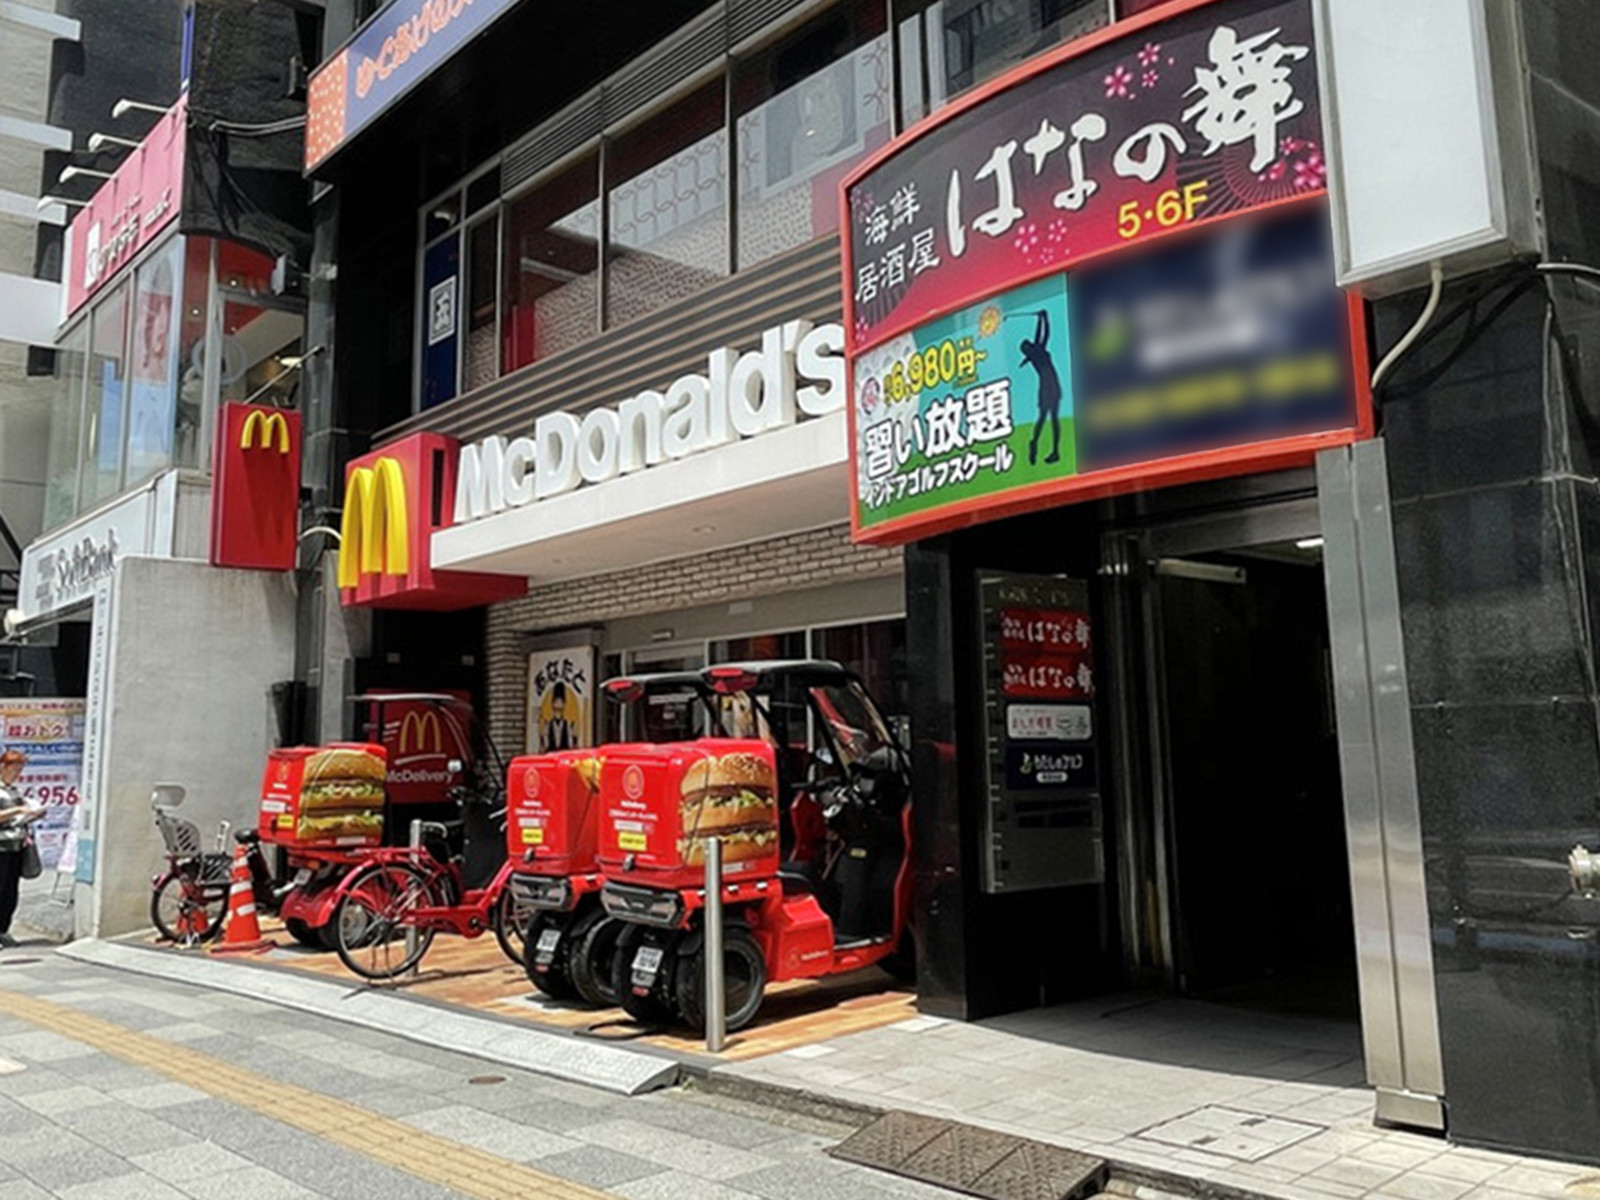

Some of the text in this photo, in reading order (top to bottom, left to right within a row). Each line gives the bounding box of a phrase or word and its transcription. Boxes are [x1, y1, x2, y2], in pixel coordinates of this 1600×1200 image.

[946, 26, 1310, 257] はなの舞
[865, 182, 920, 246] 海鮮
[855, 227, 940, 304] 居酒屋
[455, 319, 845, 522] McDonald's
[865, 379, 1012, 477] 習い放題
[865, 445, 1013, 508] インドアゴルフスクール
